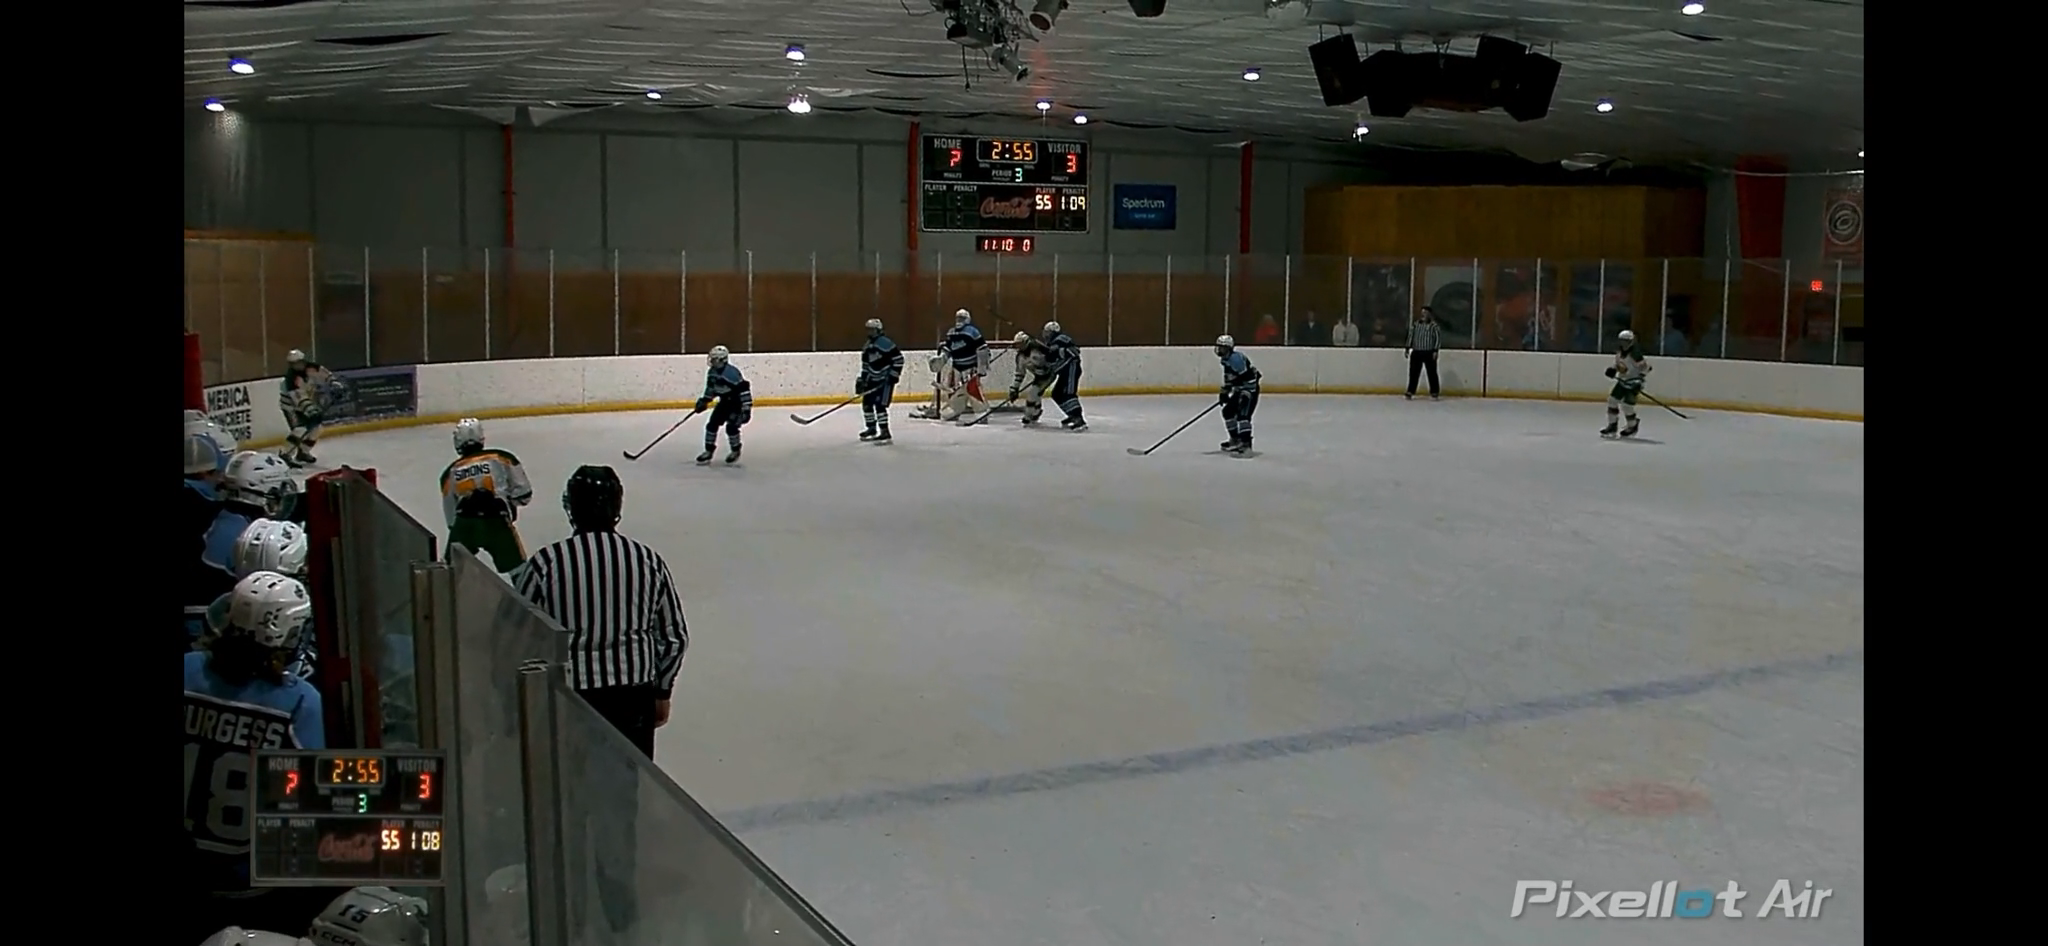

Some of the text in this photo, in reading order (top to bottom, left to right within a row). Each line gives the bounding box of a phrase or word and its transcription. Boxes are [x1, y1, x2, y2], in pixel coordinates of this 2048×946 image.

[934, 138, 962, 149] HOME
[991, 142, 1033, 160] 2:55
[1048, 143, 1081, 154] VISITOR
[1066, 155, 1077, 173] 3
[1015, 168, 1023, 182] 3
[1035, 195, 1052, 210] 55
[1122, 196, 1166, 211] Spectrum
[454, 463, 490, 481] SIMONS
[184, 703, 285, 750] URGESS
[321, 930, 356, 946] CCM
